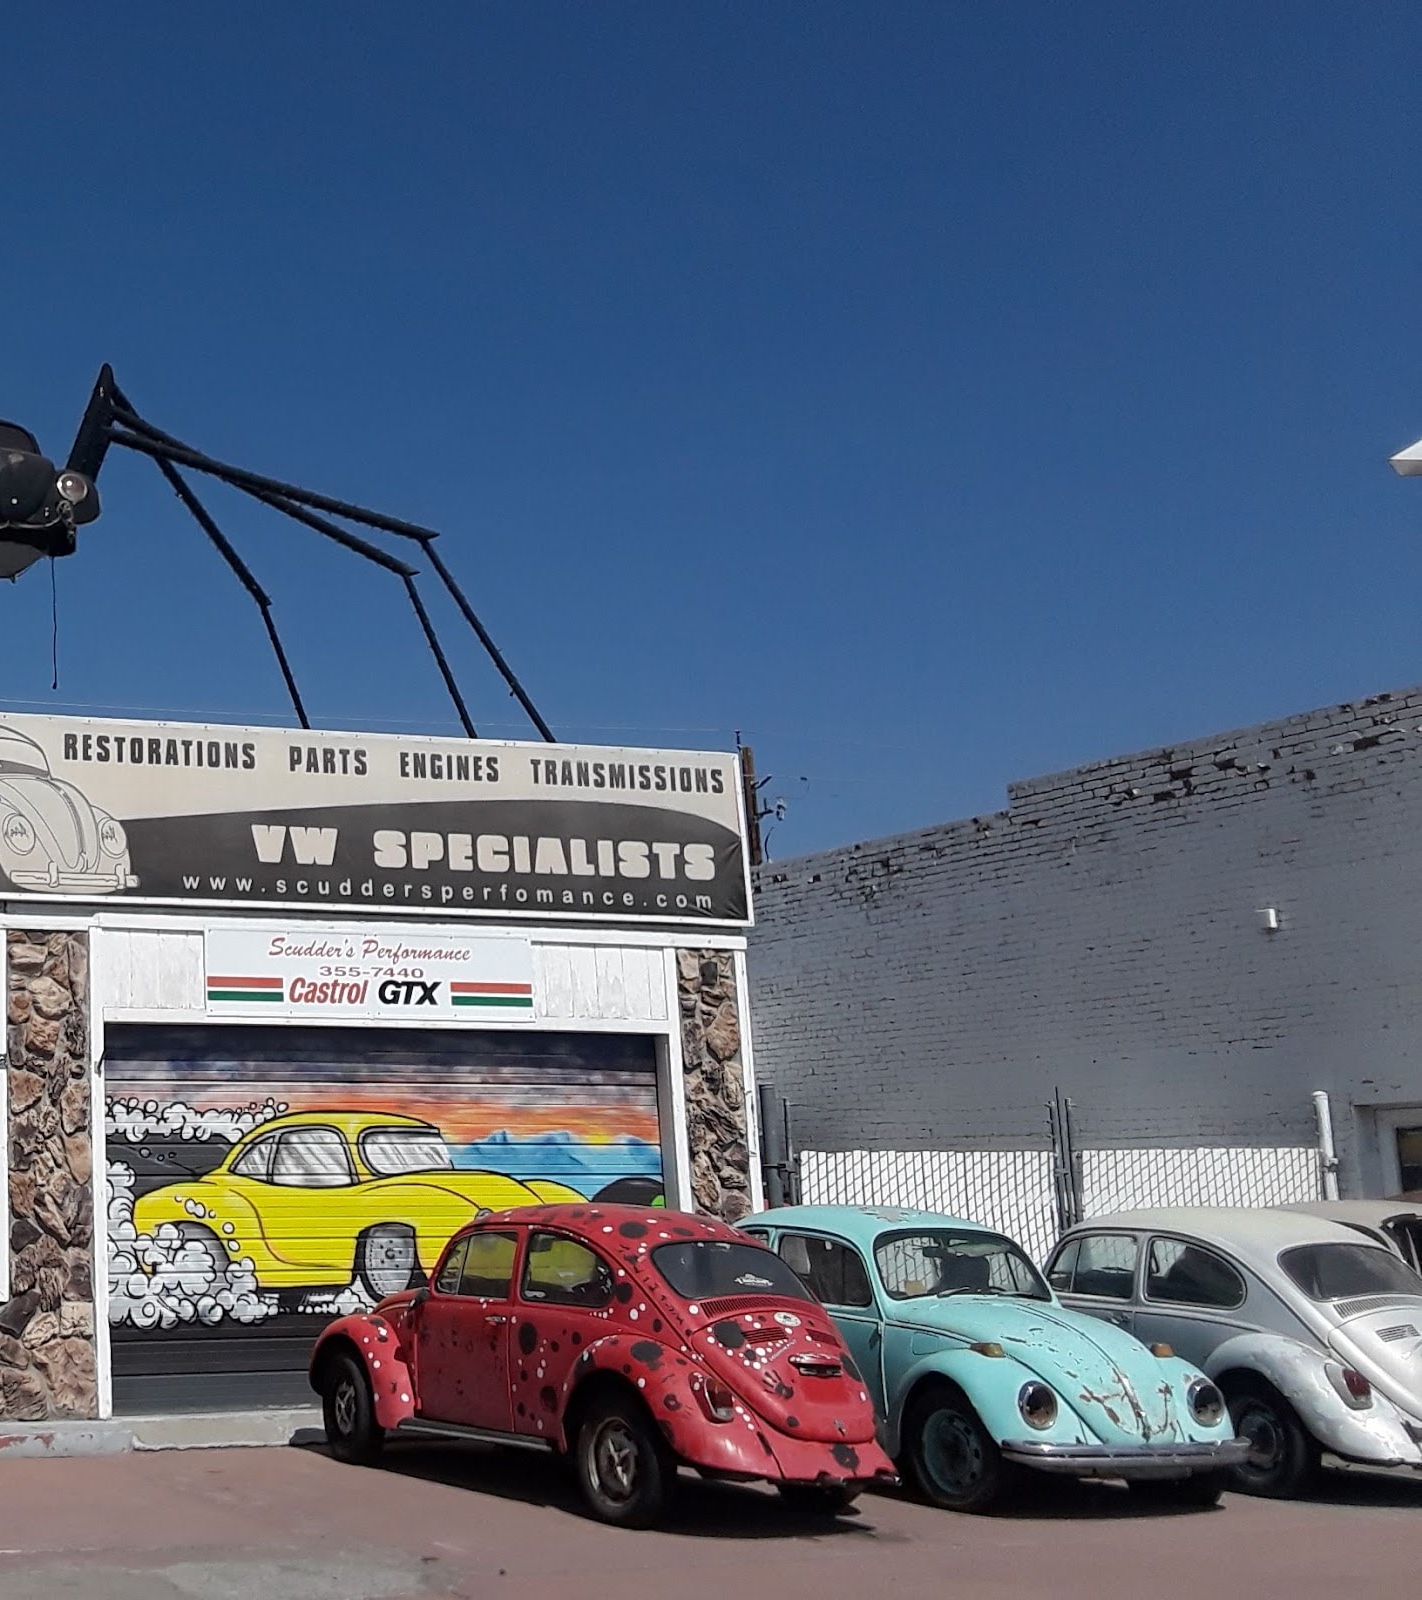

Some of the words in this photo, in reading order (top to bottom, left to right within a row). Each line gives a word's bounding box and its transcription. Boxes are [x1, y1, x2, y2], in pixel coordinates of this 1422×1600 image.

[64, 733, 256, 769] RESTORATIONS
[289, 745, 368, 775] PARTS
[400, 752, 499, 782] ENGINES
[530, 758, 724, 794] TRANSMISSIONS
[251, 824, 338, 866] VW
[372, 830, 716, 881] SPECIALISTS
[182, 874, 712, 909] www.scuddersperfomance.com
[268, 937, 356, 959] Scudder's
[361, 939, 471, 964] Performance
[319, 966, 424, 979] 355-7440
[289, 977, 368, 1005] Castrol
[378, 980, 442, 1005] GTX
